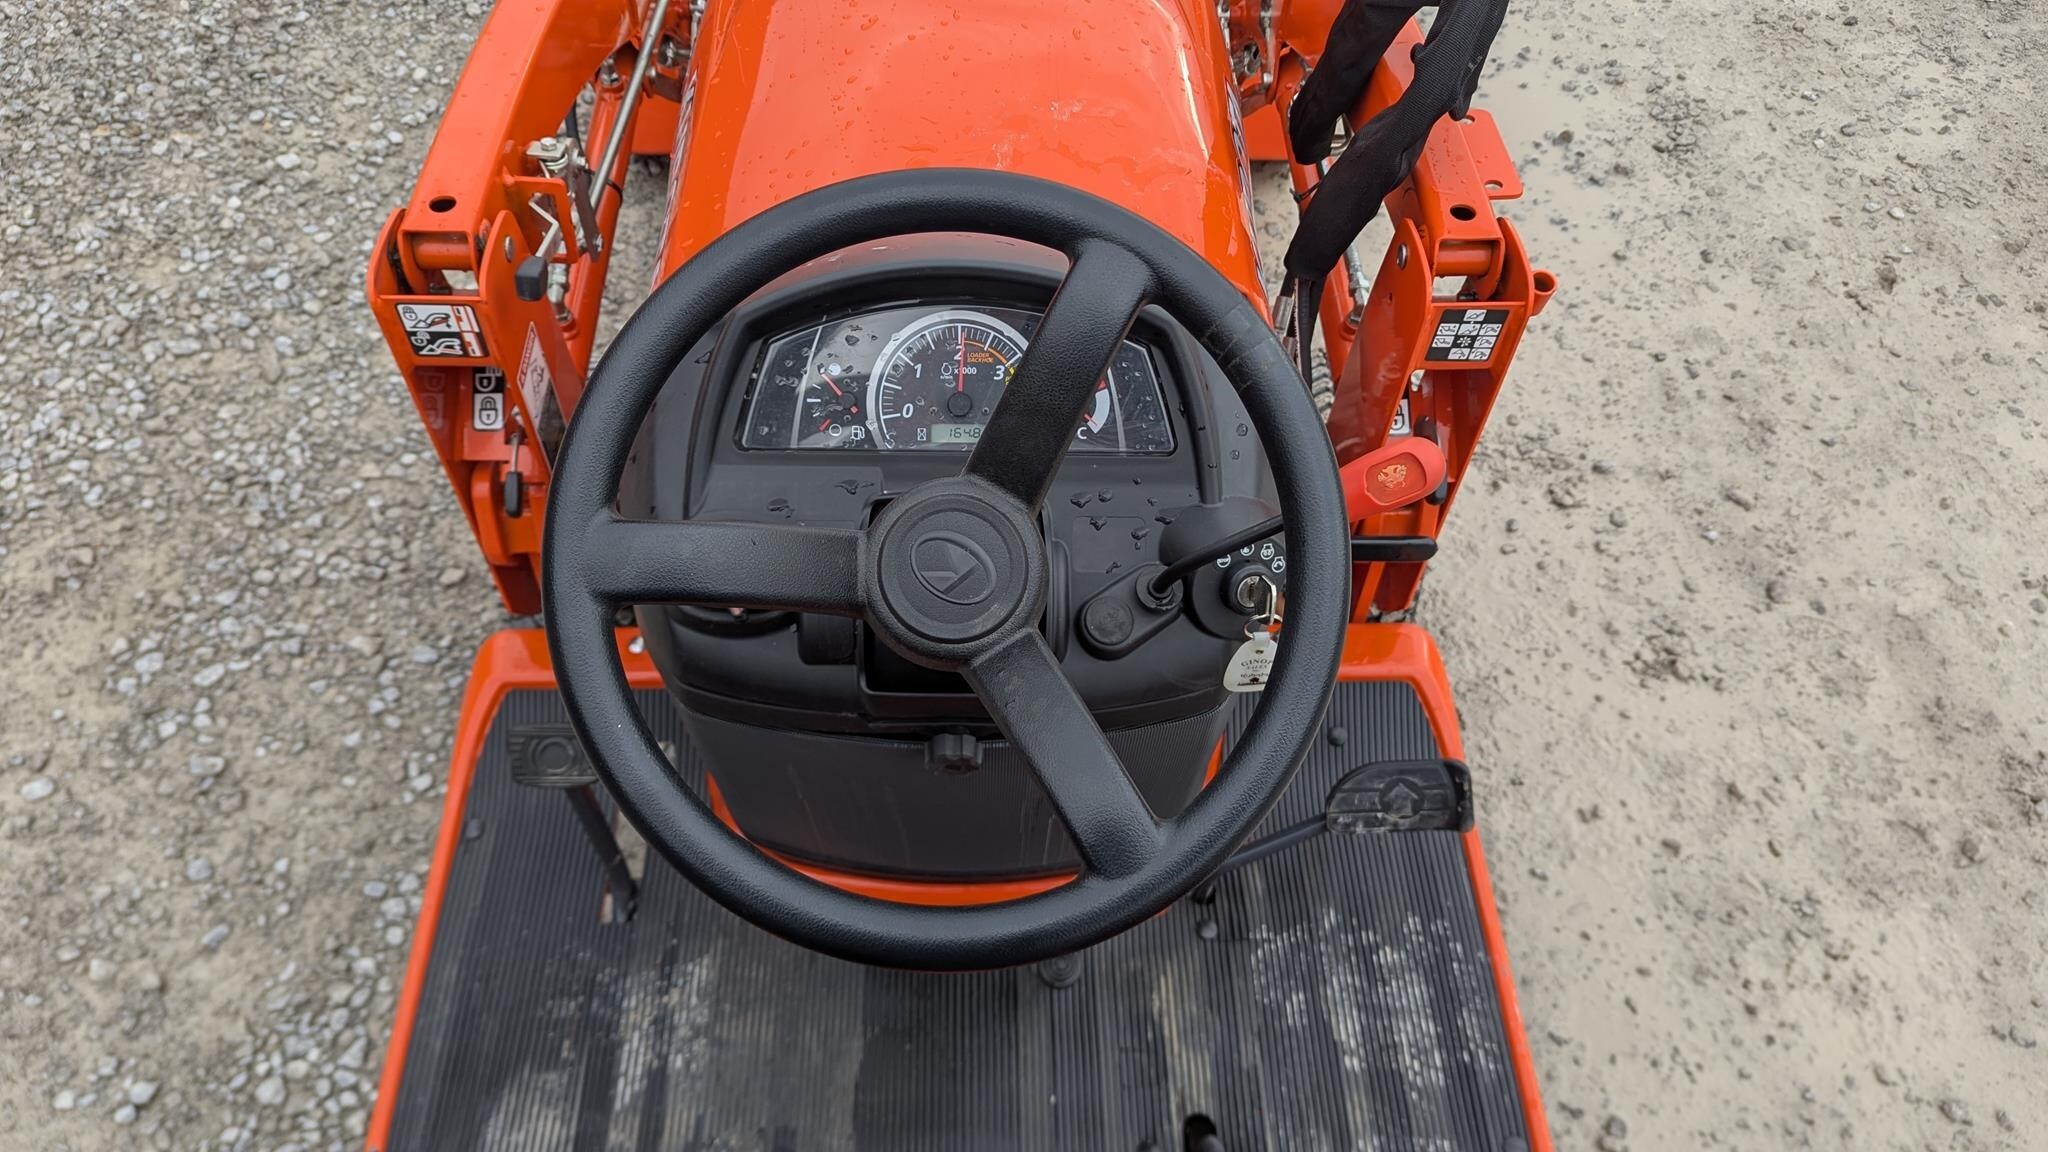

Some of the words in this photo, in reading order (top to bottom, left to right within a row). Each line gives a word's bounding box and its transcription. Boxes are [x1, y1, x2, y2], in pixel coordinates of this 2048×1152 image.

[953, 346, 964, 360] 2
[913, 363, 922, 378] 1
[993, 365, 1005, 380] 3
[902, 403, 914, 418] 0
[1077, 427, 1088, 439] C
